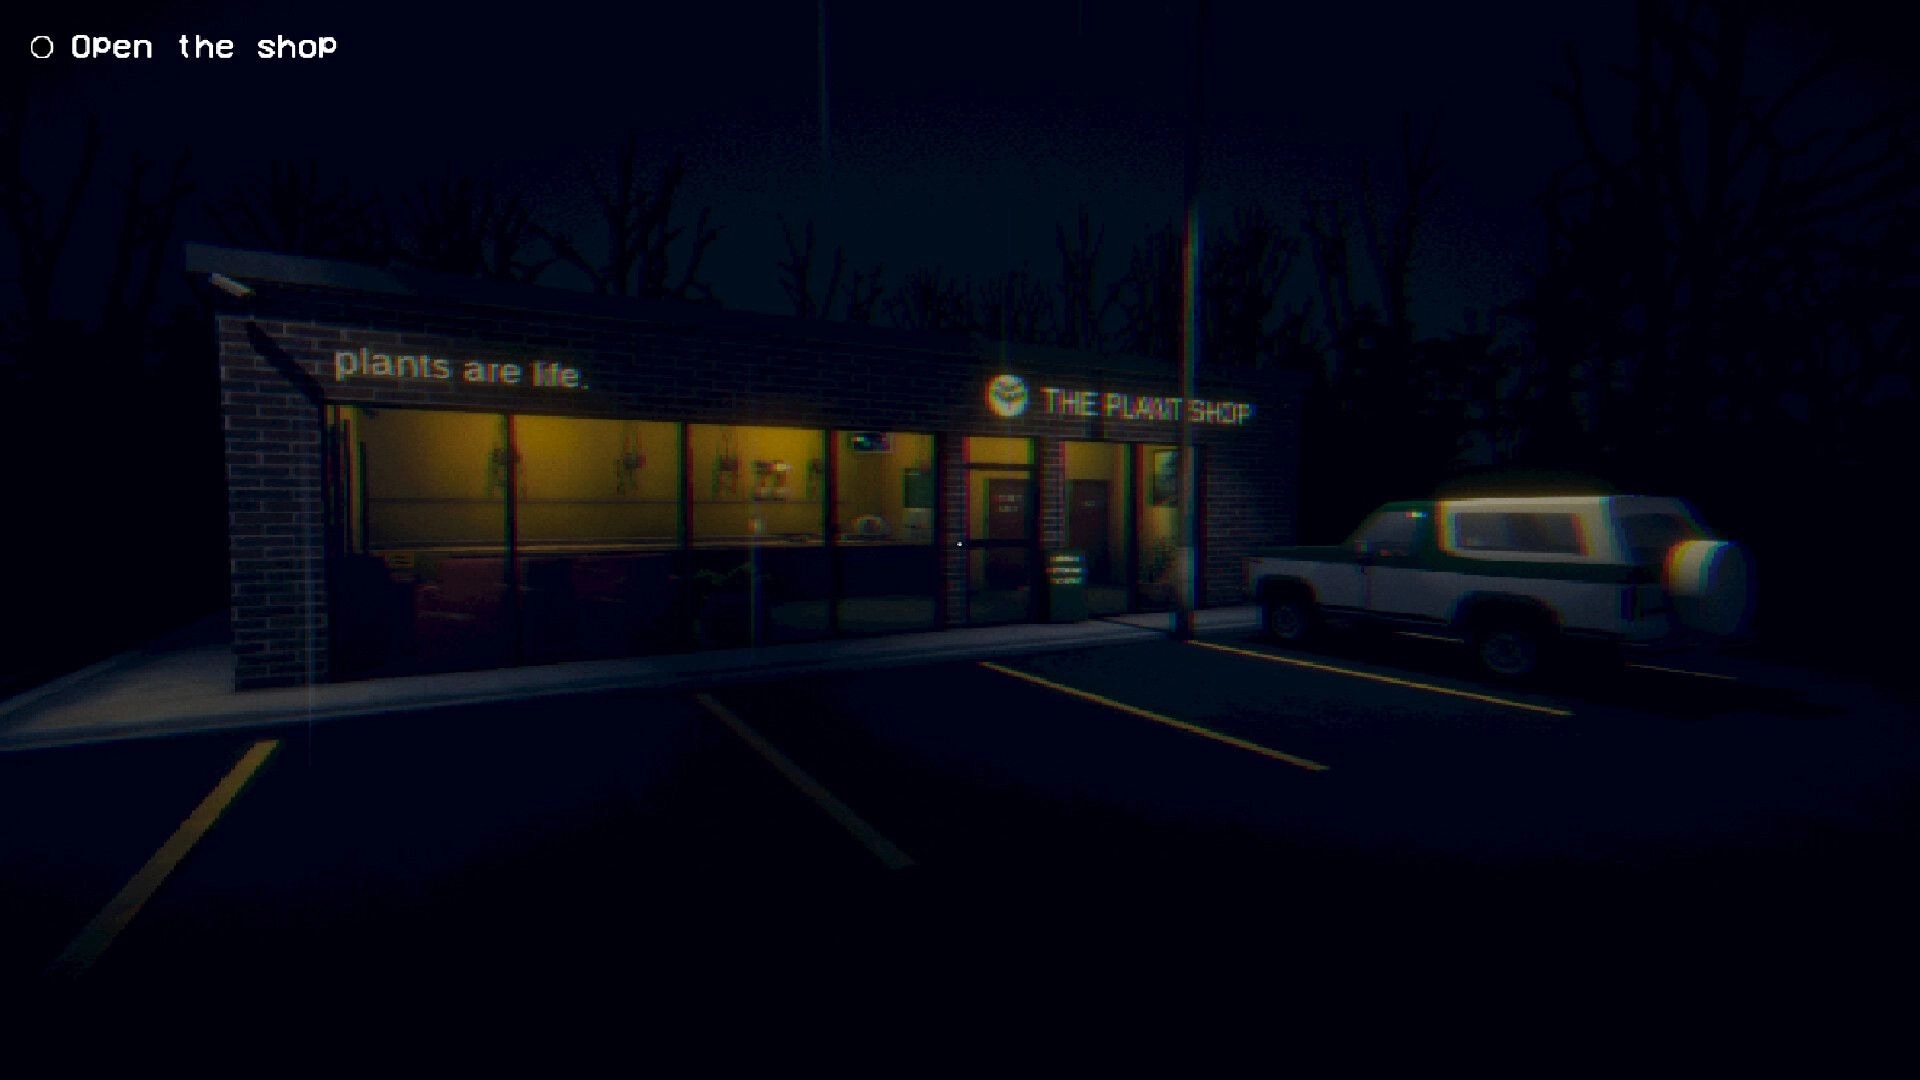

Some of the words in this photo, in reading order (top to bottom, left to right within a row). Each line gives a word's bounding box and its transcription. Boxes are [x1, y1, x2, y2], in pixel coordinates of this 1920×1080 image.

[333, 347, 451, 381] plants
[463, 359, 522, 385] are
[531, 358, 591, 391] life.
[1040, 386, 1099, 417] THE
[1102, 391, 1183, 421] PLANT
[1188, 398, 1254, 425] SHOP
